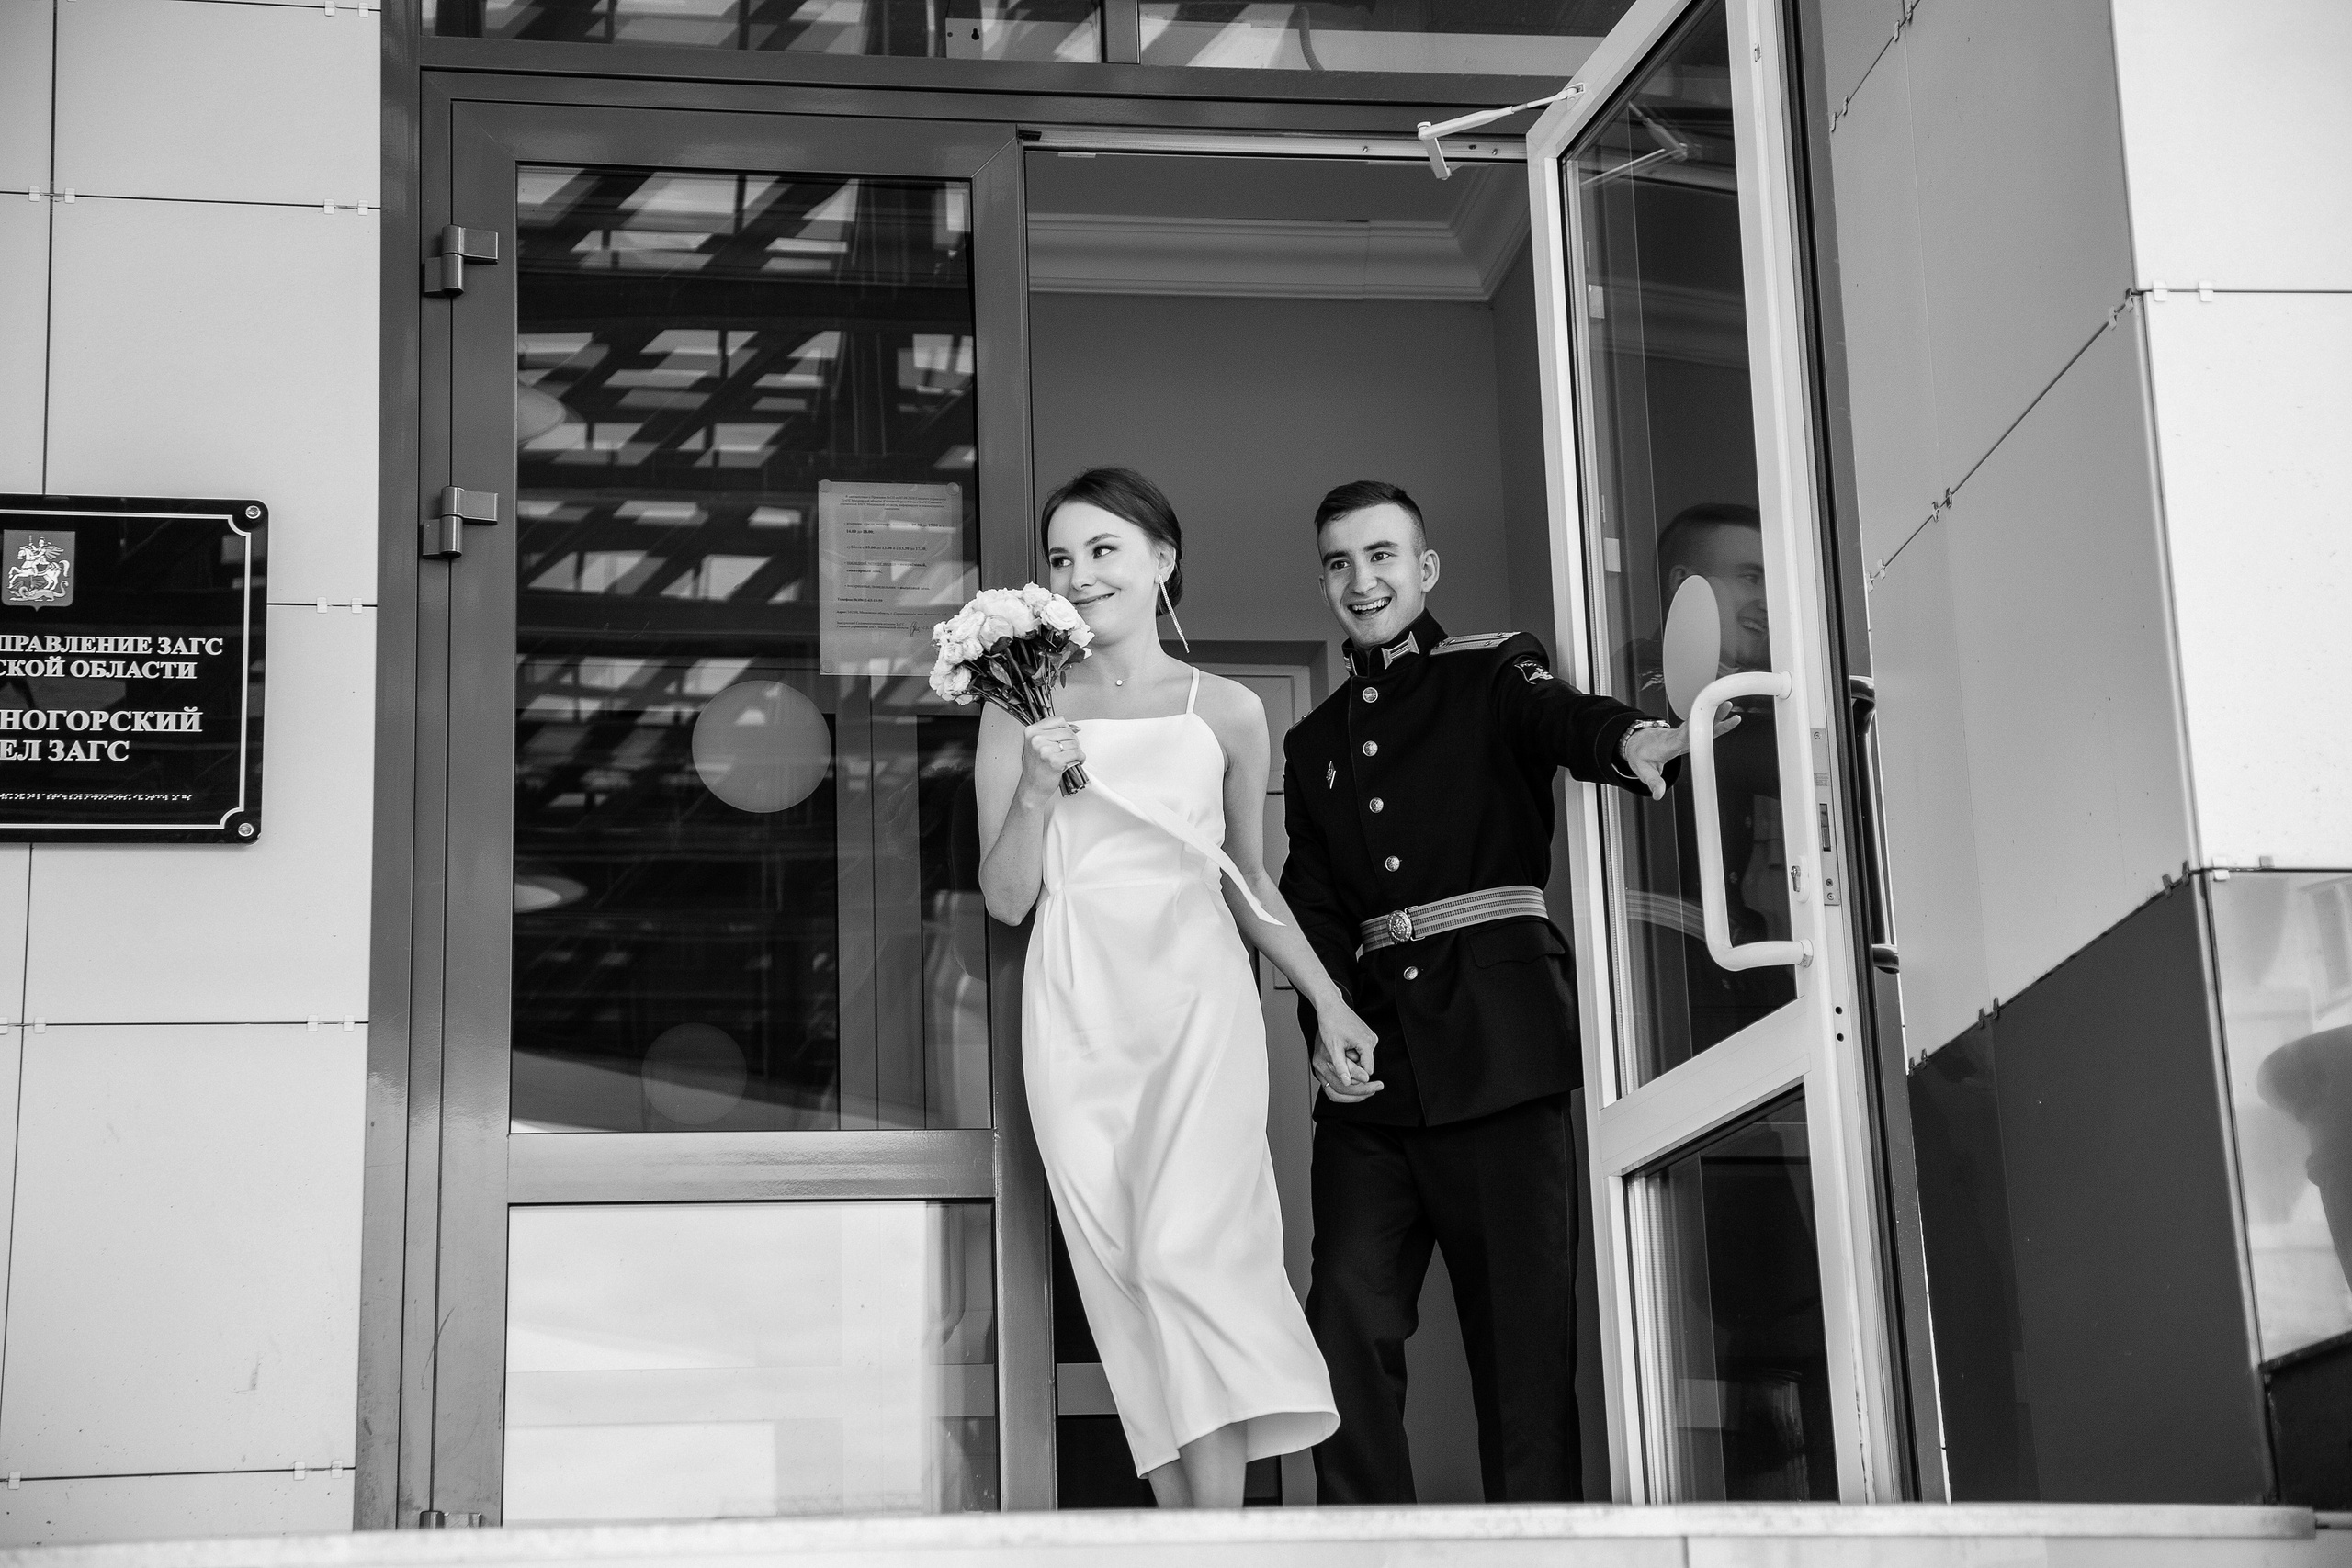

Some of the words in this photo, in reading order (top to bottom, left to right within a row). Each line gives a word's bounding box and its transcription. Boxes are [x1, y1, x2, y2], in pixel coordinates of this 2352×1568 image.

[157, 637, 223, 656] ЗАГС
[69, 660, 198, 679] ОБЛАСТИ
[0, 705, 204, 733] НОГОРСКИЙ
[0, 739, 42, 761] ЕЛ
[47, 739, 130, 762] ЗАГС
